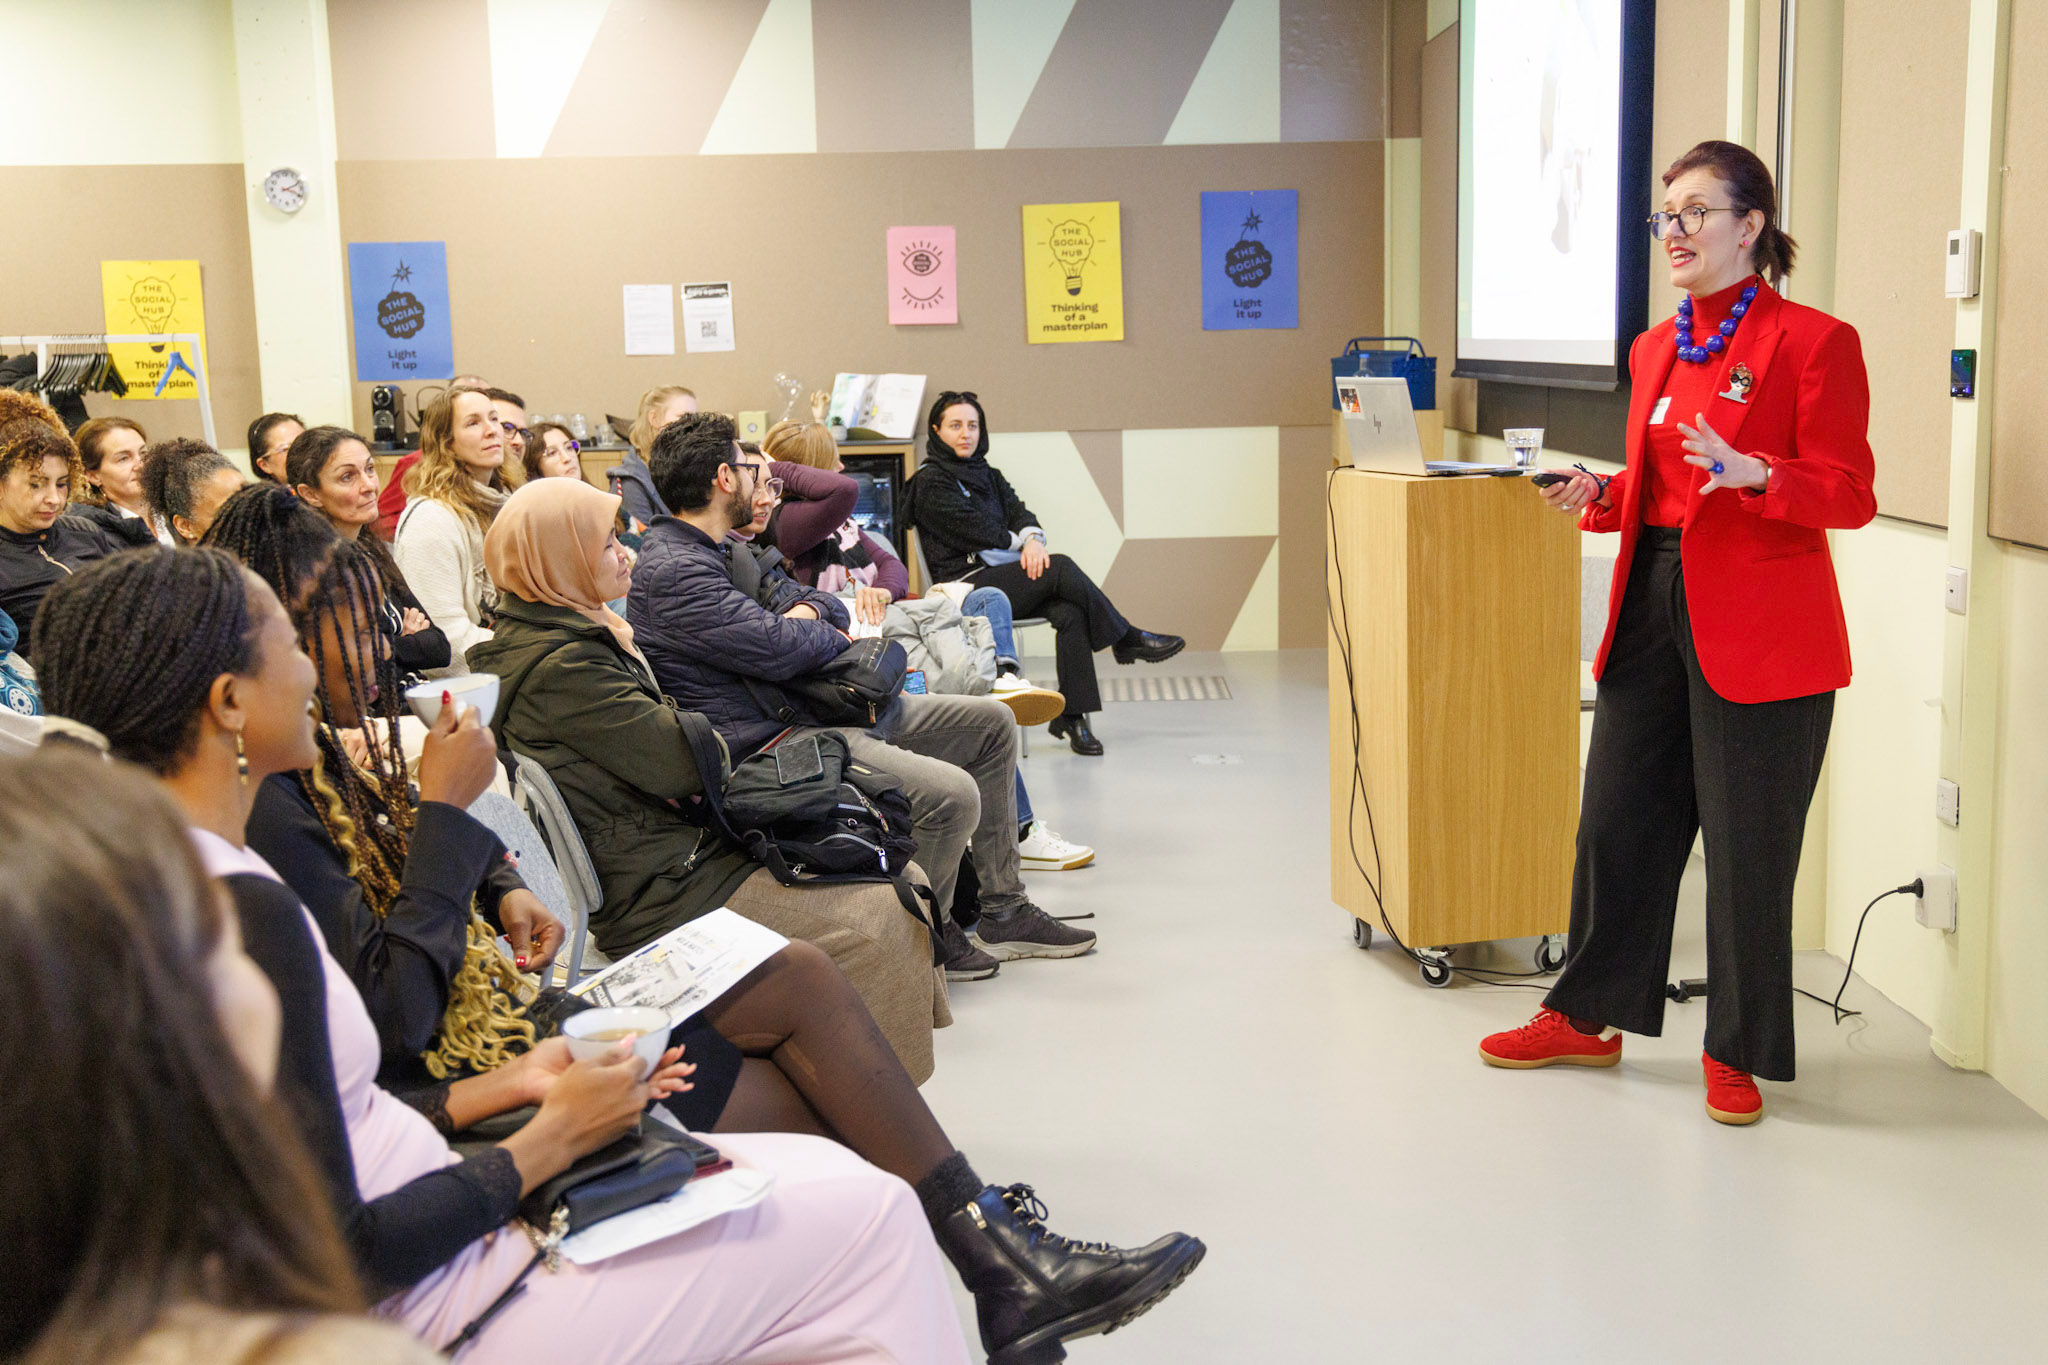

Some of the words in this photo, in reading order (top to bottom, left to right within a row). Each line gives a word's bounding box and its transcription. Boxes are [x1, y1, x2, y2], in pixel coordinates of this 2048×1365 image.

[1054, 238, 1089, 246] SOCIAL
[1062, 249, 1082, 257] HUB
[1234, 246, 1256, 259] THE
[1229, 256, 1270, 274] SOCIAL
[1240, 268, 1264, 282] HUB
[385, 297, 408, 311] THE
[1051, 303, 1099, 313] Thinking
[1233, 299, 1262, 309] Light
[381, 306, 422, 325] SOCIAL
[1064, 313, 1075, 321] of
[1236, 310, 1245, 318] it
[1247, 311, 1262, 319] up
[393, 319, 417, 334] HUB
[1043, 322, 1108, 332] masterplan
[387, 349, 416, 360] Light
[391, 361, 399, 369] it
[148, 369, 160, 378] of
